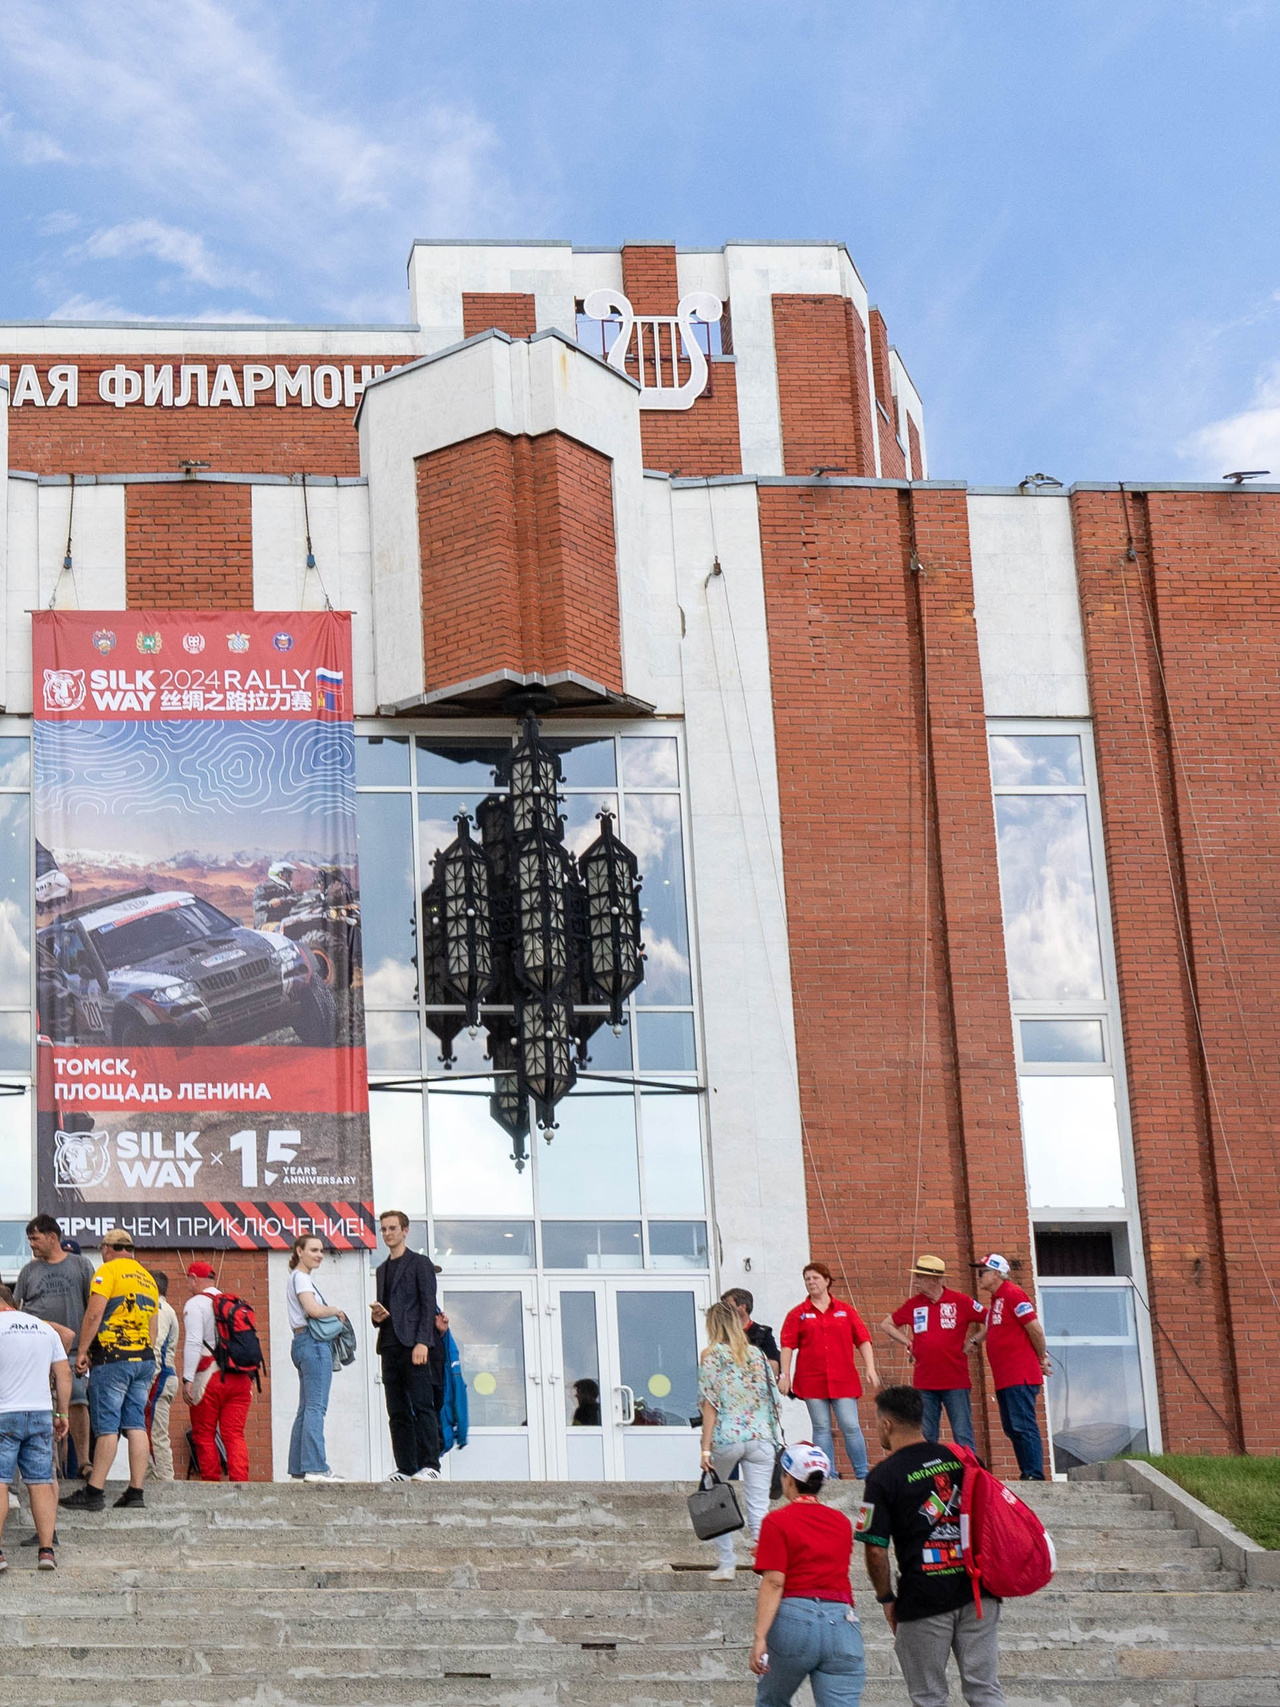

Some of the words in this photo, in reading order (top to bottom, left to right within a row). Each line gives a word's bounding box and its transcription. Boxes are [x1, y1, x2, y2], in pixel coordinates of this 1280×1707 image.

[91, 670, 155, 690] SILK
[160, 669, 220, 690] 2024
[225, 669, 310, 690] RALLY
[91, 691, 156, 711] WAY
[160, 690, 312, 712] 丝绸之路拉力赛
[54, 1058, 136, 1078] ТОМСК,
[54, 1082, 173, 1102] ПЛОЩАДЬ
[177, 1082, 271, 1100] ЛЕНИНА
[116, 1131, 203, 1159] SILK
[230, 1129, 301, 1188] 15
[117, 1161, 199, 1188] WAY
[282, 1166, 318, 1175] YEARS
[282, 1176, 357, 1186] ANNIVERSARY
[55, 1217, 116, 1236] ЯРЧЕ
[122, 1217, 170, 1237] ЧЕМ
[178, 1217, 365, 1238] ПРИКЛЮЧЕНИЕ!
